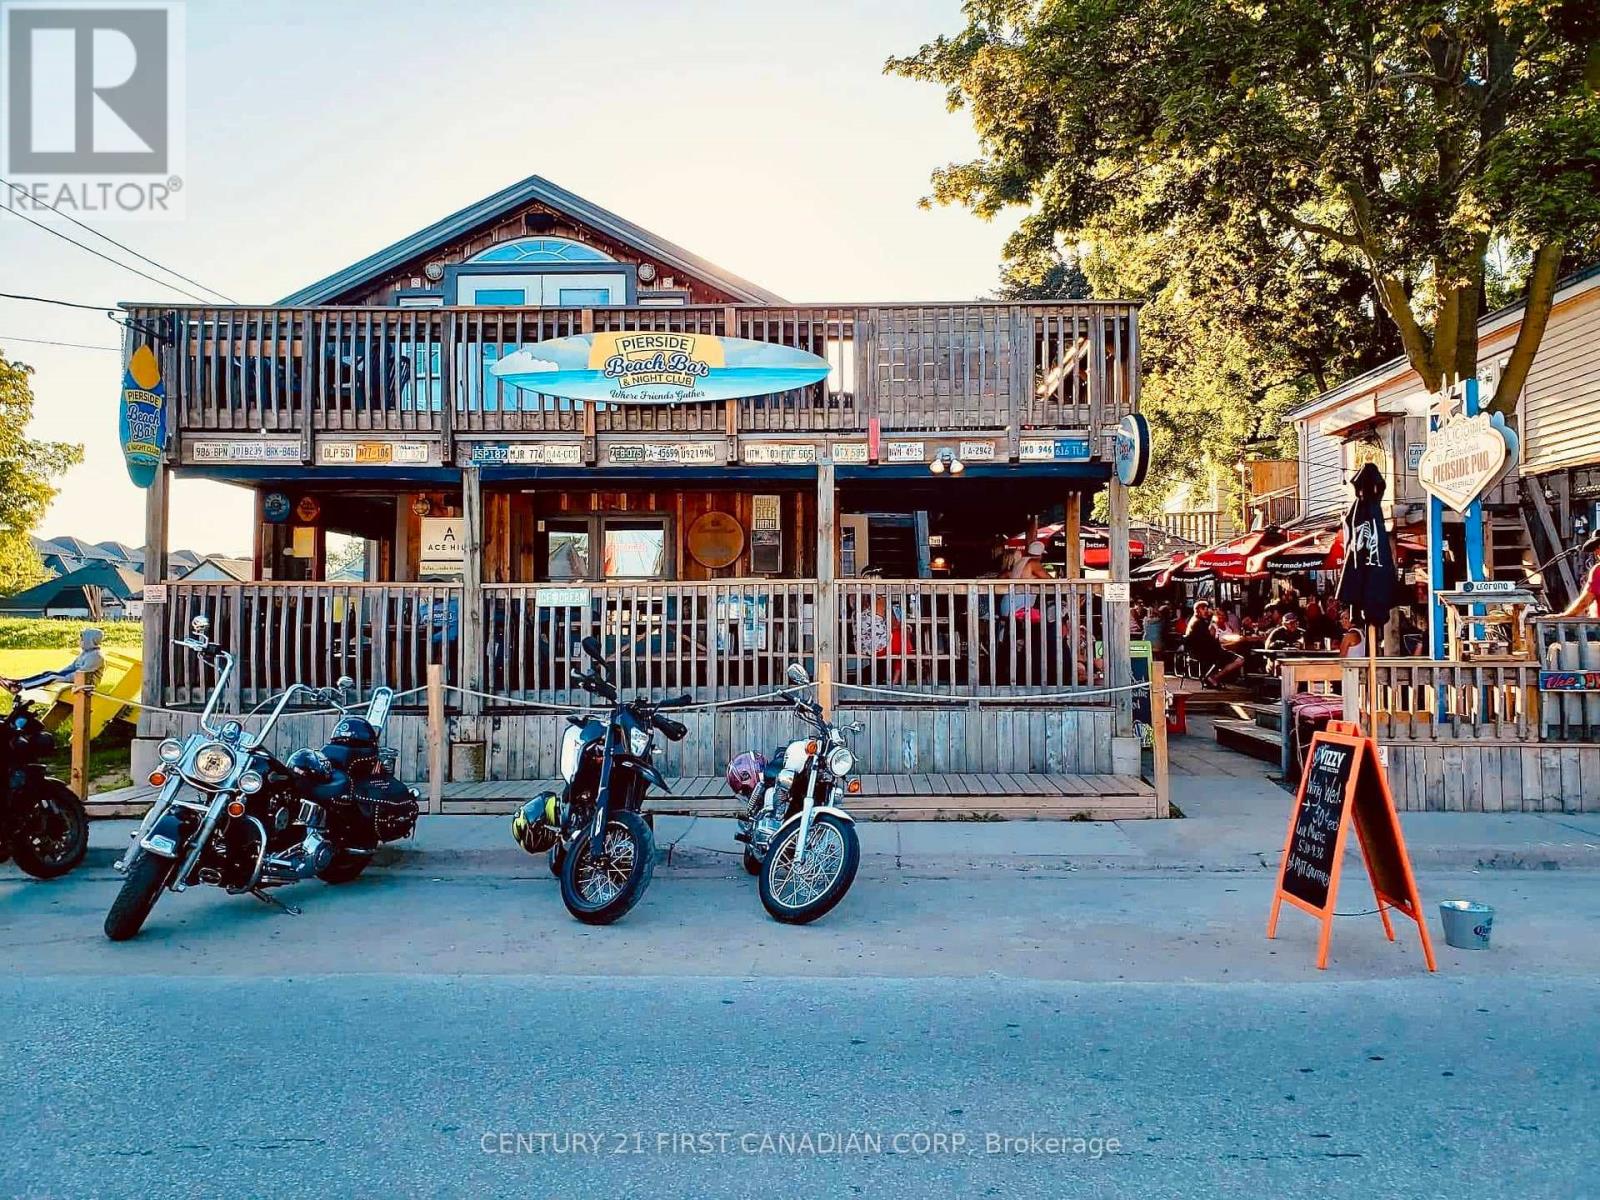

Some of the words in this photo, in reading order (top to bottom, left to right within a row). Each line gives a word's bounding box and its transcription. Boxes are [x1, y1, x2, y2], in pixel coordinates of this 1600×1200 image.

[622, 336, 689, 350] PIERSIDE
[605, 352, 666, 377] Beach
[667, 353, 709, 376] Bar
[632, 374, 662, 383] NIGHT
[665, 374, 692, 386] CLUB
[128, 391, 160, 406] PIERSIDE
[609, 389, 638, 399] Where
[640, 390, 674, 400] Friends
[675, 389, 706, 401] Gather
[127, 404, 160, 426] Beach
[133, 421, 157, 439] Bar
[1432, 456, 1470, 484] PIERSIDE
[1471, 450, 1490, 472] PUB
[1476, 582, 1508, 591] Corona
[1320, 749, 1346, 769] VIZZY
